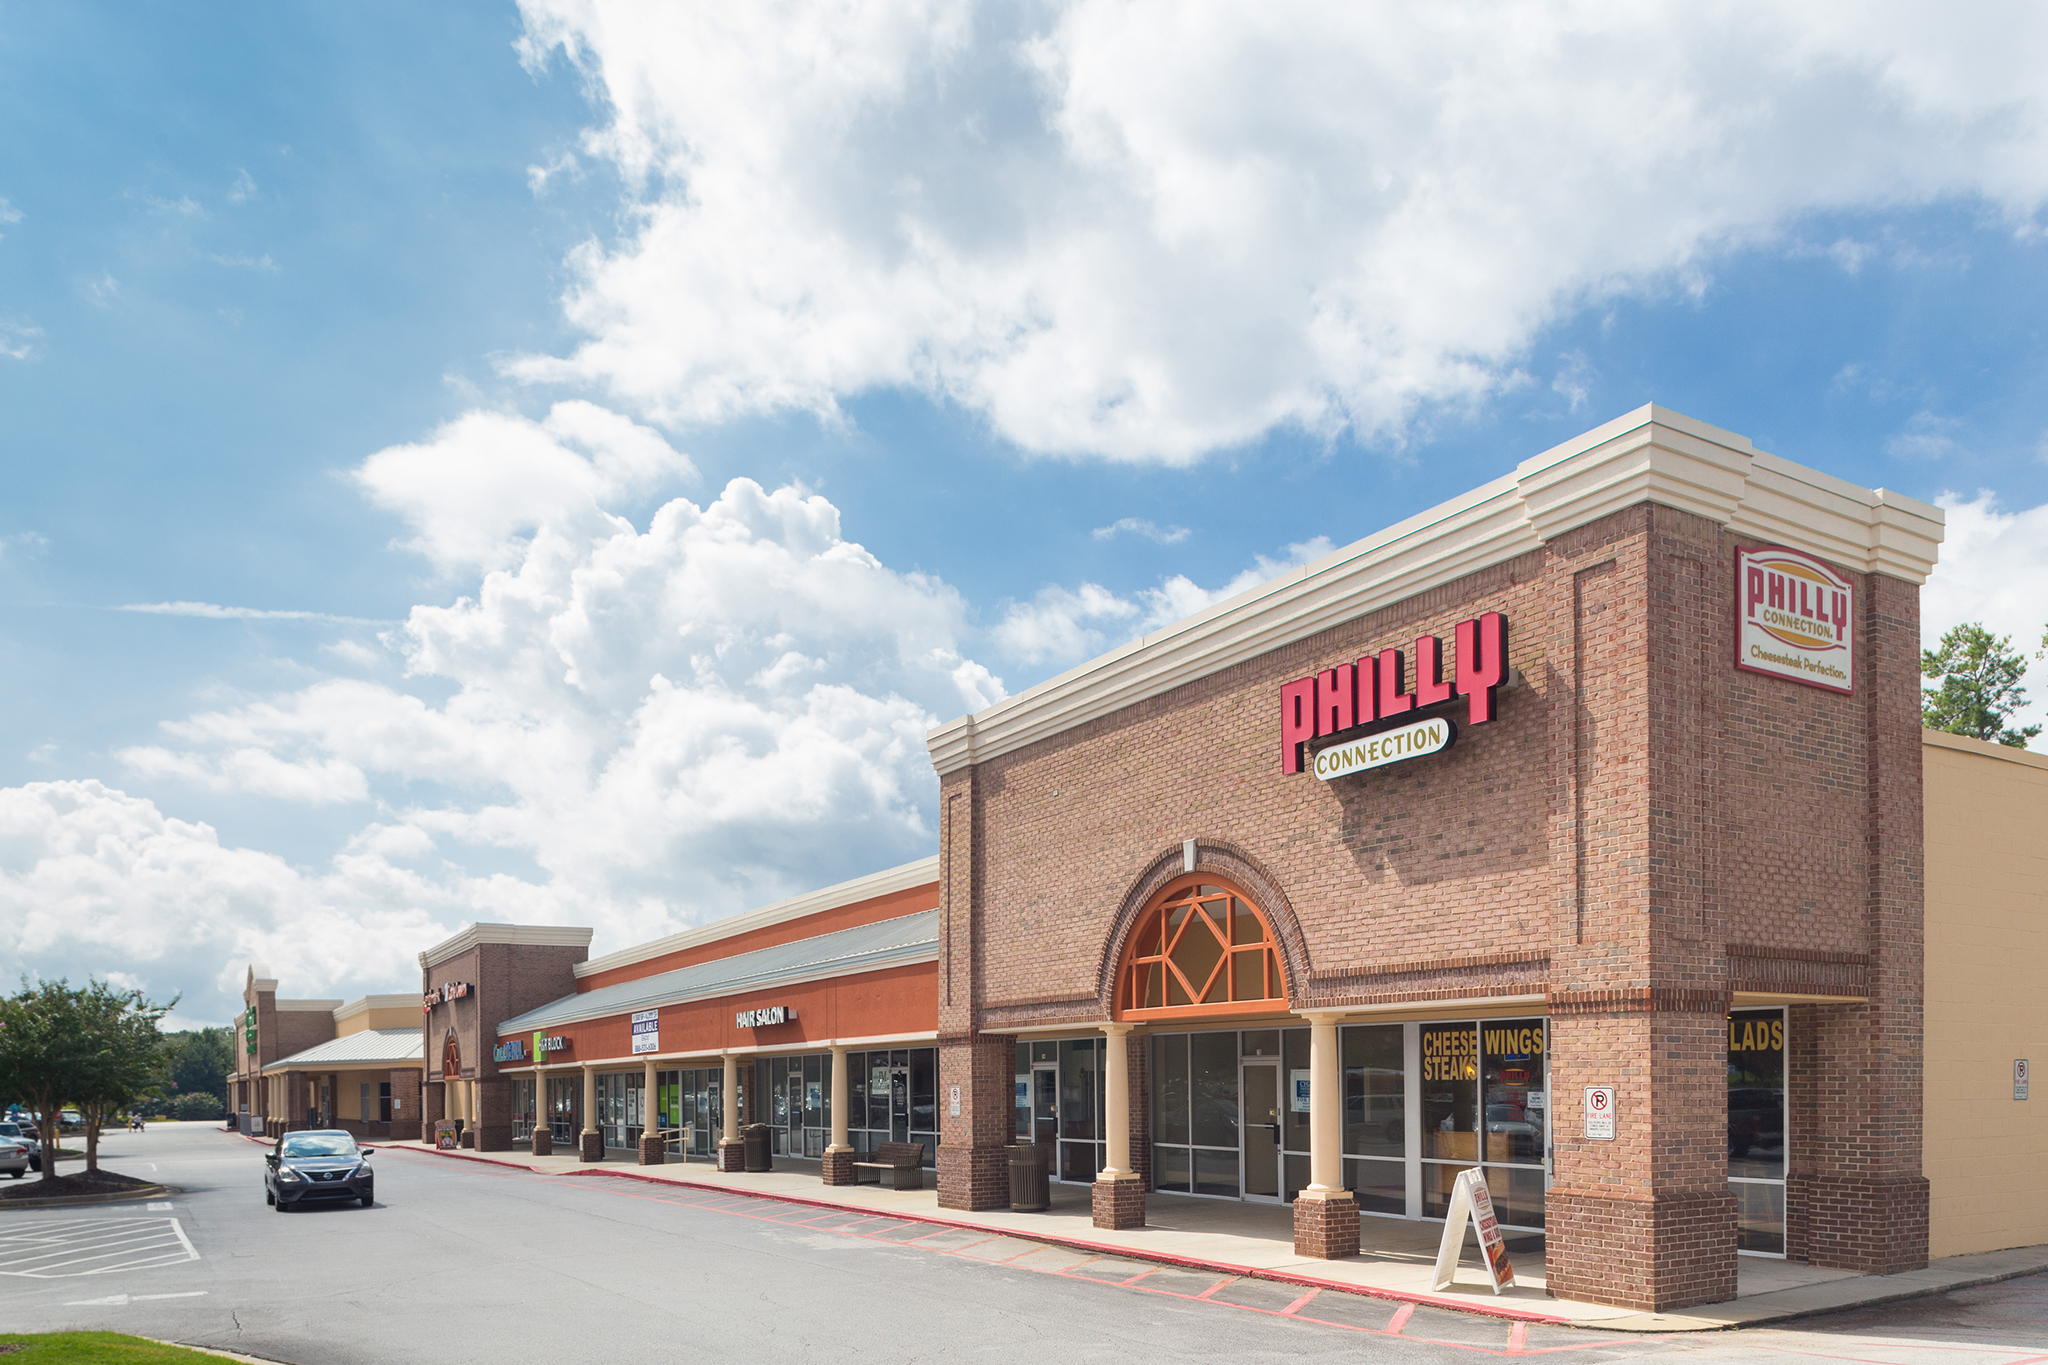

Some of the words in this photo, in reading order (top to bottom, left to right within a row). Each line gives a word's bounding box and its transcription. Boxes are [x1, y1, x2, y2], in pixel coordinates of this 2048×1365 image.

[1748, 565, 1847, 641] PHILLY
[1751, 644, 1802, 669] Cheesesteak
[1281, 611, 1504, 775] PHILLY
[1316, 724, 1441, 775] CONNECTION
[633, 1020, 658, 1035] AVAILABLE
[736, 1010, 755, 1029] HAIR
[756, 1006, 784, 1027] SALON
[548, 1036, 564, 1051] BLOCK
[1423, 1030, 1477, 1056] CHEESE
[1484, 1028, 1543, 1055] WINGS
[1730, 1020, 1783, 1051] LADS
[1424, 1056, 1477, 1081] STEAKS
[1500, 1071, 1530, 1083] PHILLY
